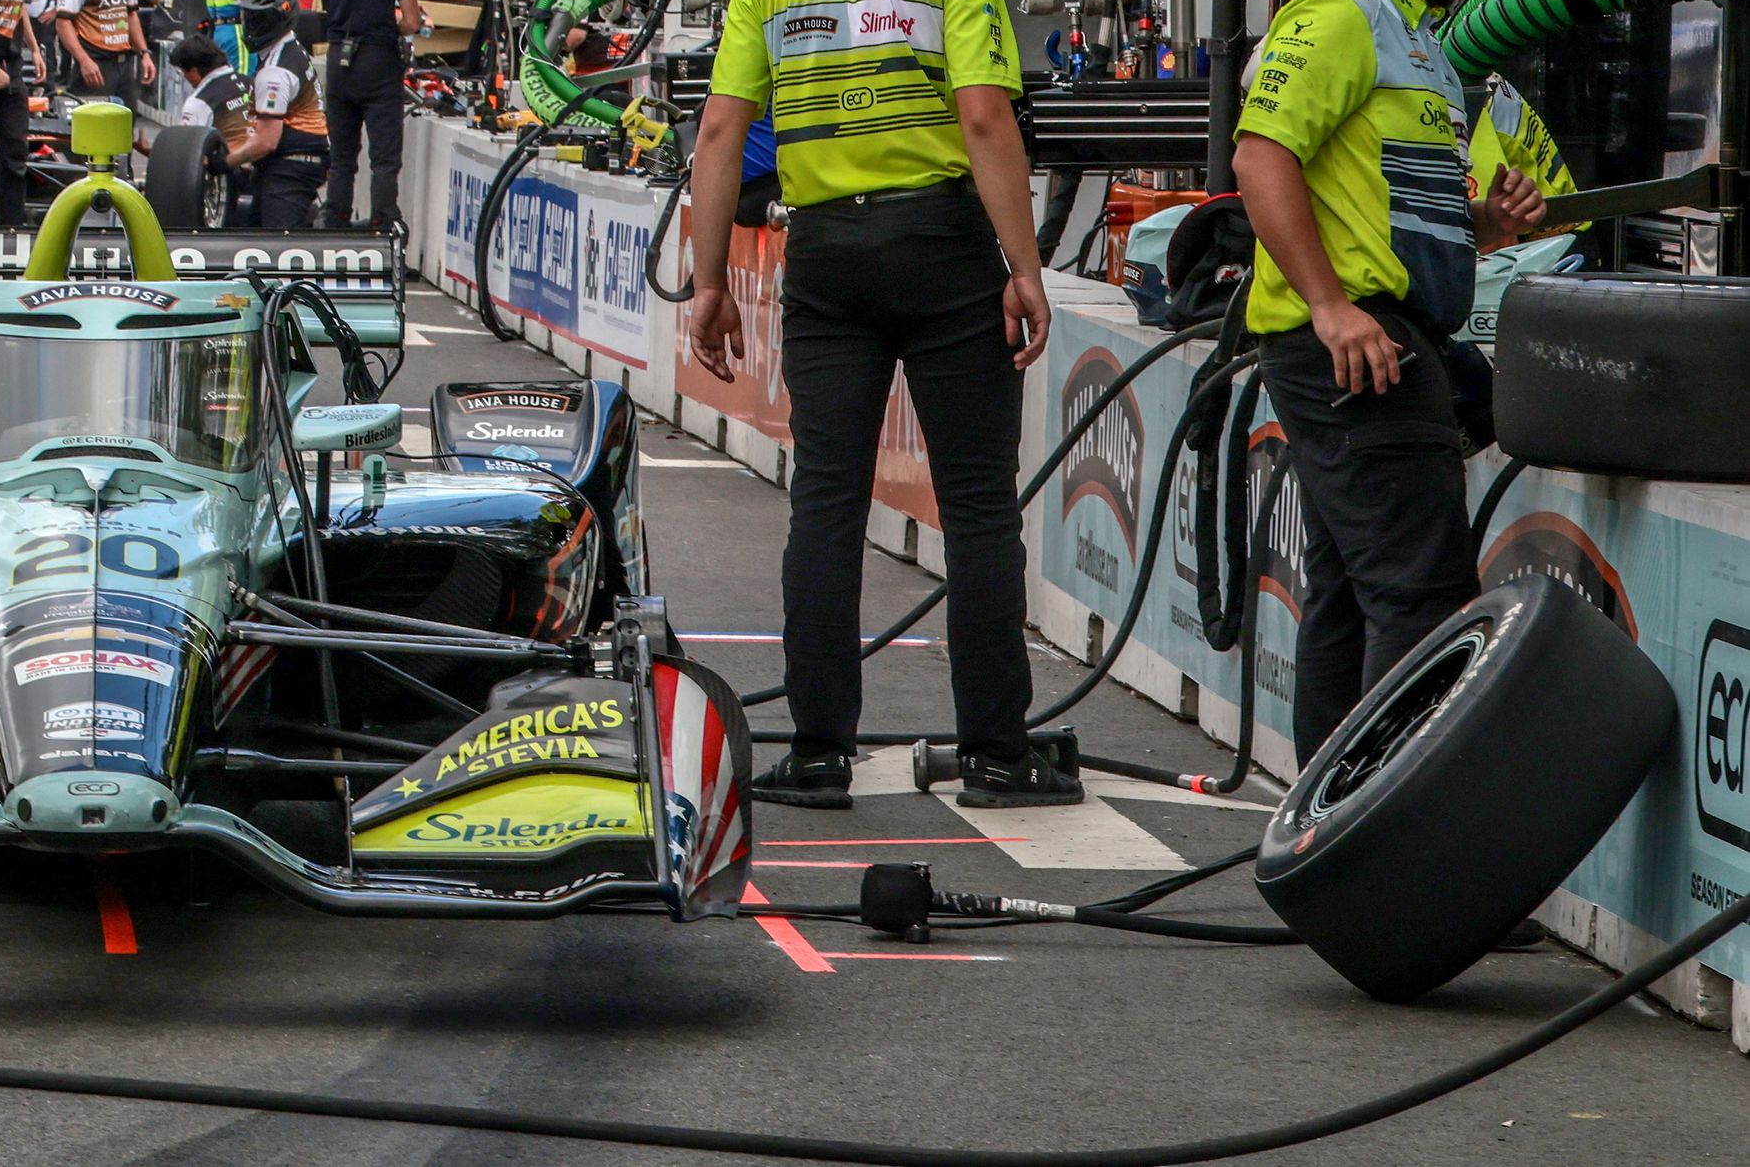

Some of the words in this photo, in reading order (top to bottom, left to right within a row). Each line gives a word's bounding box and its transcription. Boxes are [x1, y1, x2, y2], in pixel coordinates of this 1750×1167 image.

[783, 18, 802, 37] AVA
[804, 18, 834, 31] HOUSE
[1277, 51, 1308, 65] LIQUID
[1258, 82, 1279, 94] TEA
[846, 92, 867, 106] ecr
[29, 286, 82, 306] JAVA
[91, 285, 168, 307] HOUSE
[466, 395, 503, 410] JAVA
[508, 394, 561, 410] HOUSE
[466, 421, 564, 441] Splenda
[62, 435, 134, 447] @ECRIndy
[1066, 383, 1095, 480] JAVA
[1097, 383, 1137, 515] HOUSE
[11, 533, 183, 586] 20
[24, 652, 160, 673] SONAX
[84, 708, 134, 718] NTT
[43, 718, 144, 730] INDYCAR
[435, 699, 624, 782] AMERICA'S
[39, 748, 147, 762] dallara
[466, 735, 599, 777] STEVIA
[74, 782, 111, 792] ecr
[406, 813, 628, 842] Splenda
[1690, 871, 1725, 913] SEASON
